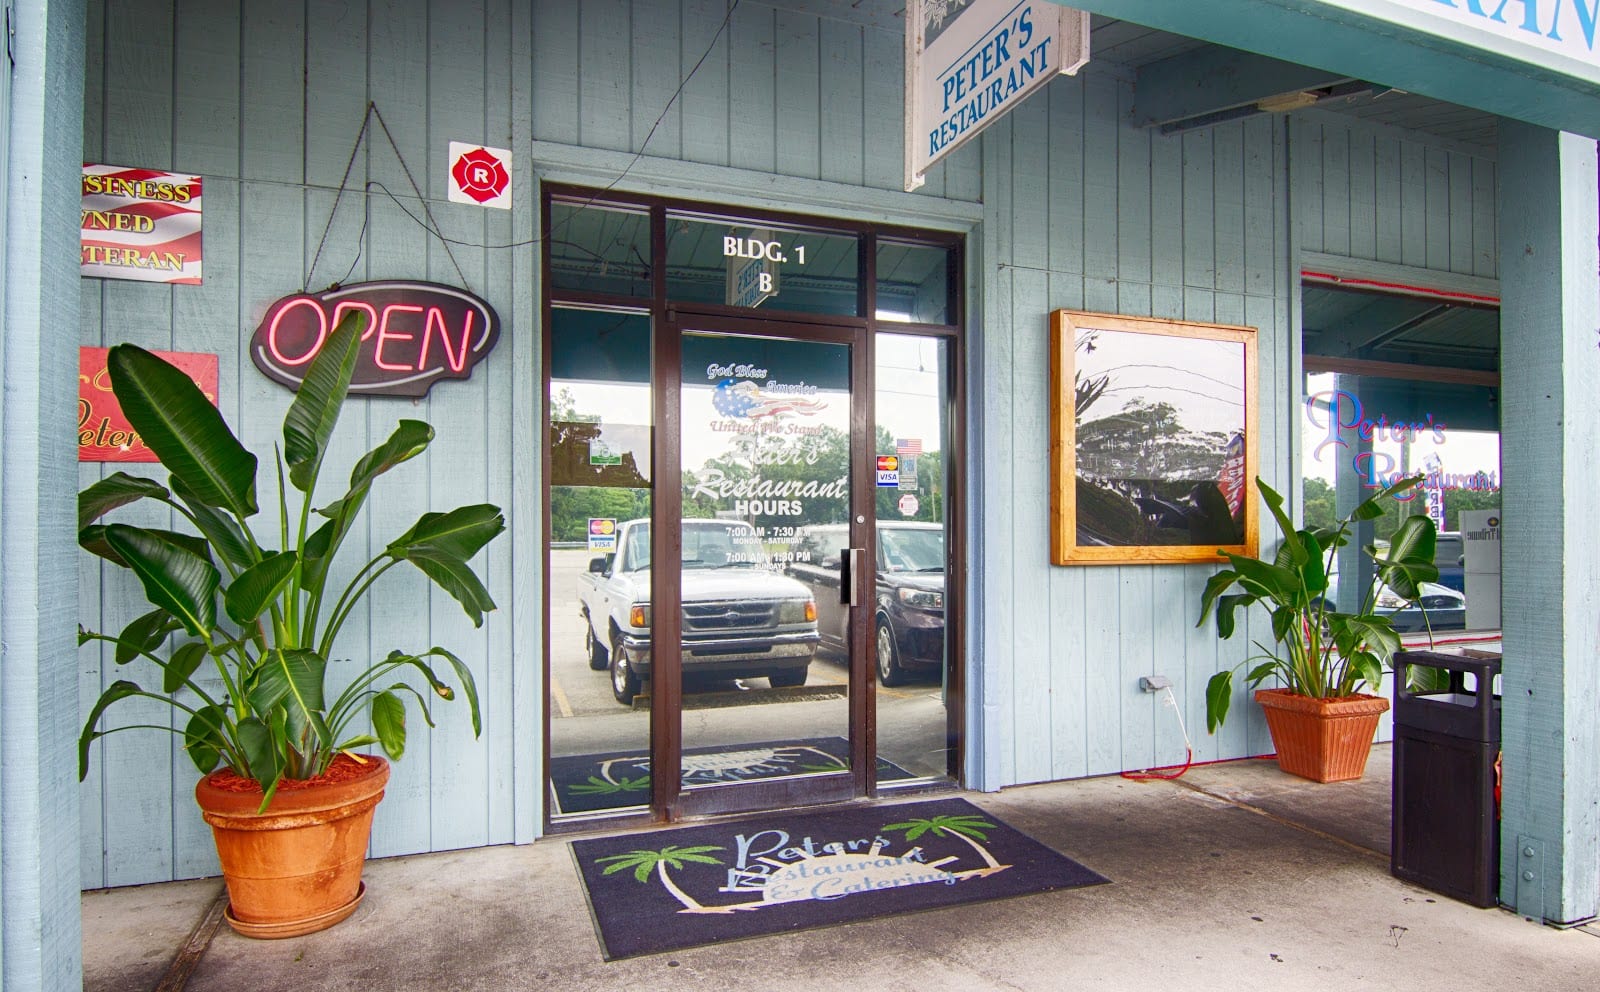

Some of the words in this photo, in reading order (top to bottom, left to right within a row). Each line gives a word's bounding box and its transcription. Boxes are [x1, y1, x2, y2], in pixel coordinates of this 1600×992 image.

[942, 6, 1033, 113] PETER'S
[929, 36, 1052, 157] RESTAURANT
[82, 174, 191, 203] SINESS
[474, 167, 489, 183] R
[82, 245, 185, 272] TERAN
[724, 236, 788, 263] BLDG.
[794, 245, 805, 264] 1
[759, 272, 772, 293] B
[269, 298, 474, 372] OPEN
[707, 363, 736, 379] God
[735, 364, 767, 379] Bless
[766, 380, 818, 395] America
[710, 420, 759, 433] United
[784, 423, 822, 435] Stand
[1306, 389, 1448, 462] Peter's
[691, 467, 848, 500] Restaurant
[880, 473, 897, 481] VISA
[735, 500, 803, 516] HOURS
[726, 527, 747, 537] 7:00
[750, 527, 765, 536] AM
[773, 527, 794, 537] 7:30
[726, 552, 747, 562] 7:00
[774, 552, 794, 562] 1:30
[796, 552, 811, 561] PM
[727, 848, 928, 892] Restaurant
[810, 871, 956, 900] Catering
